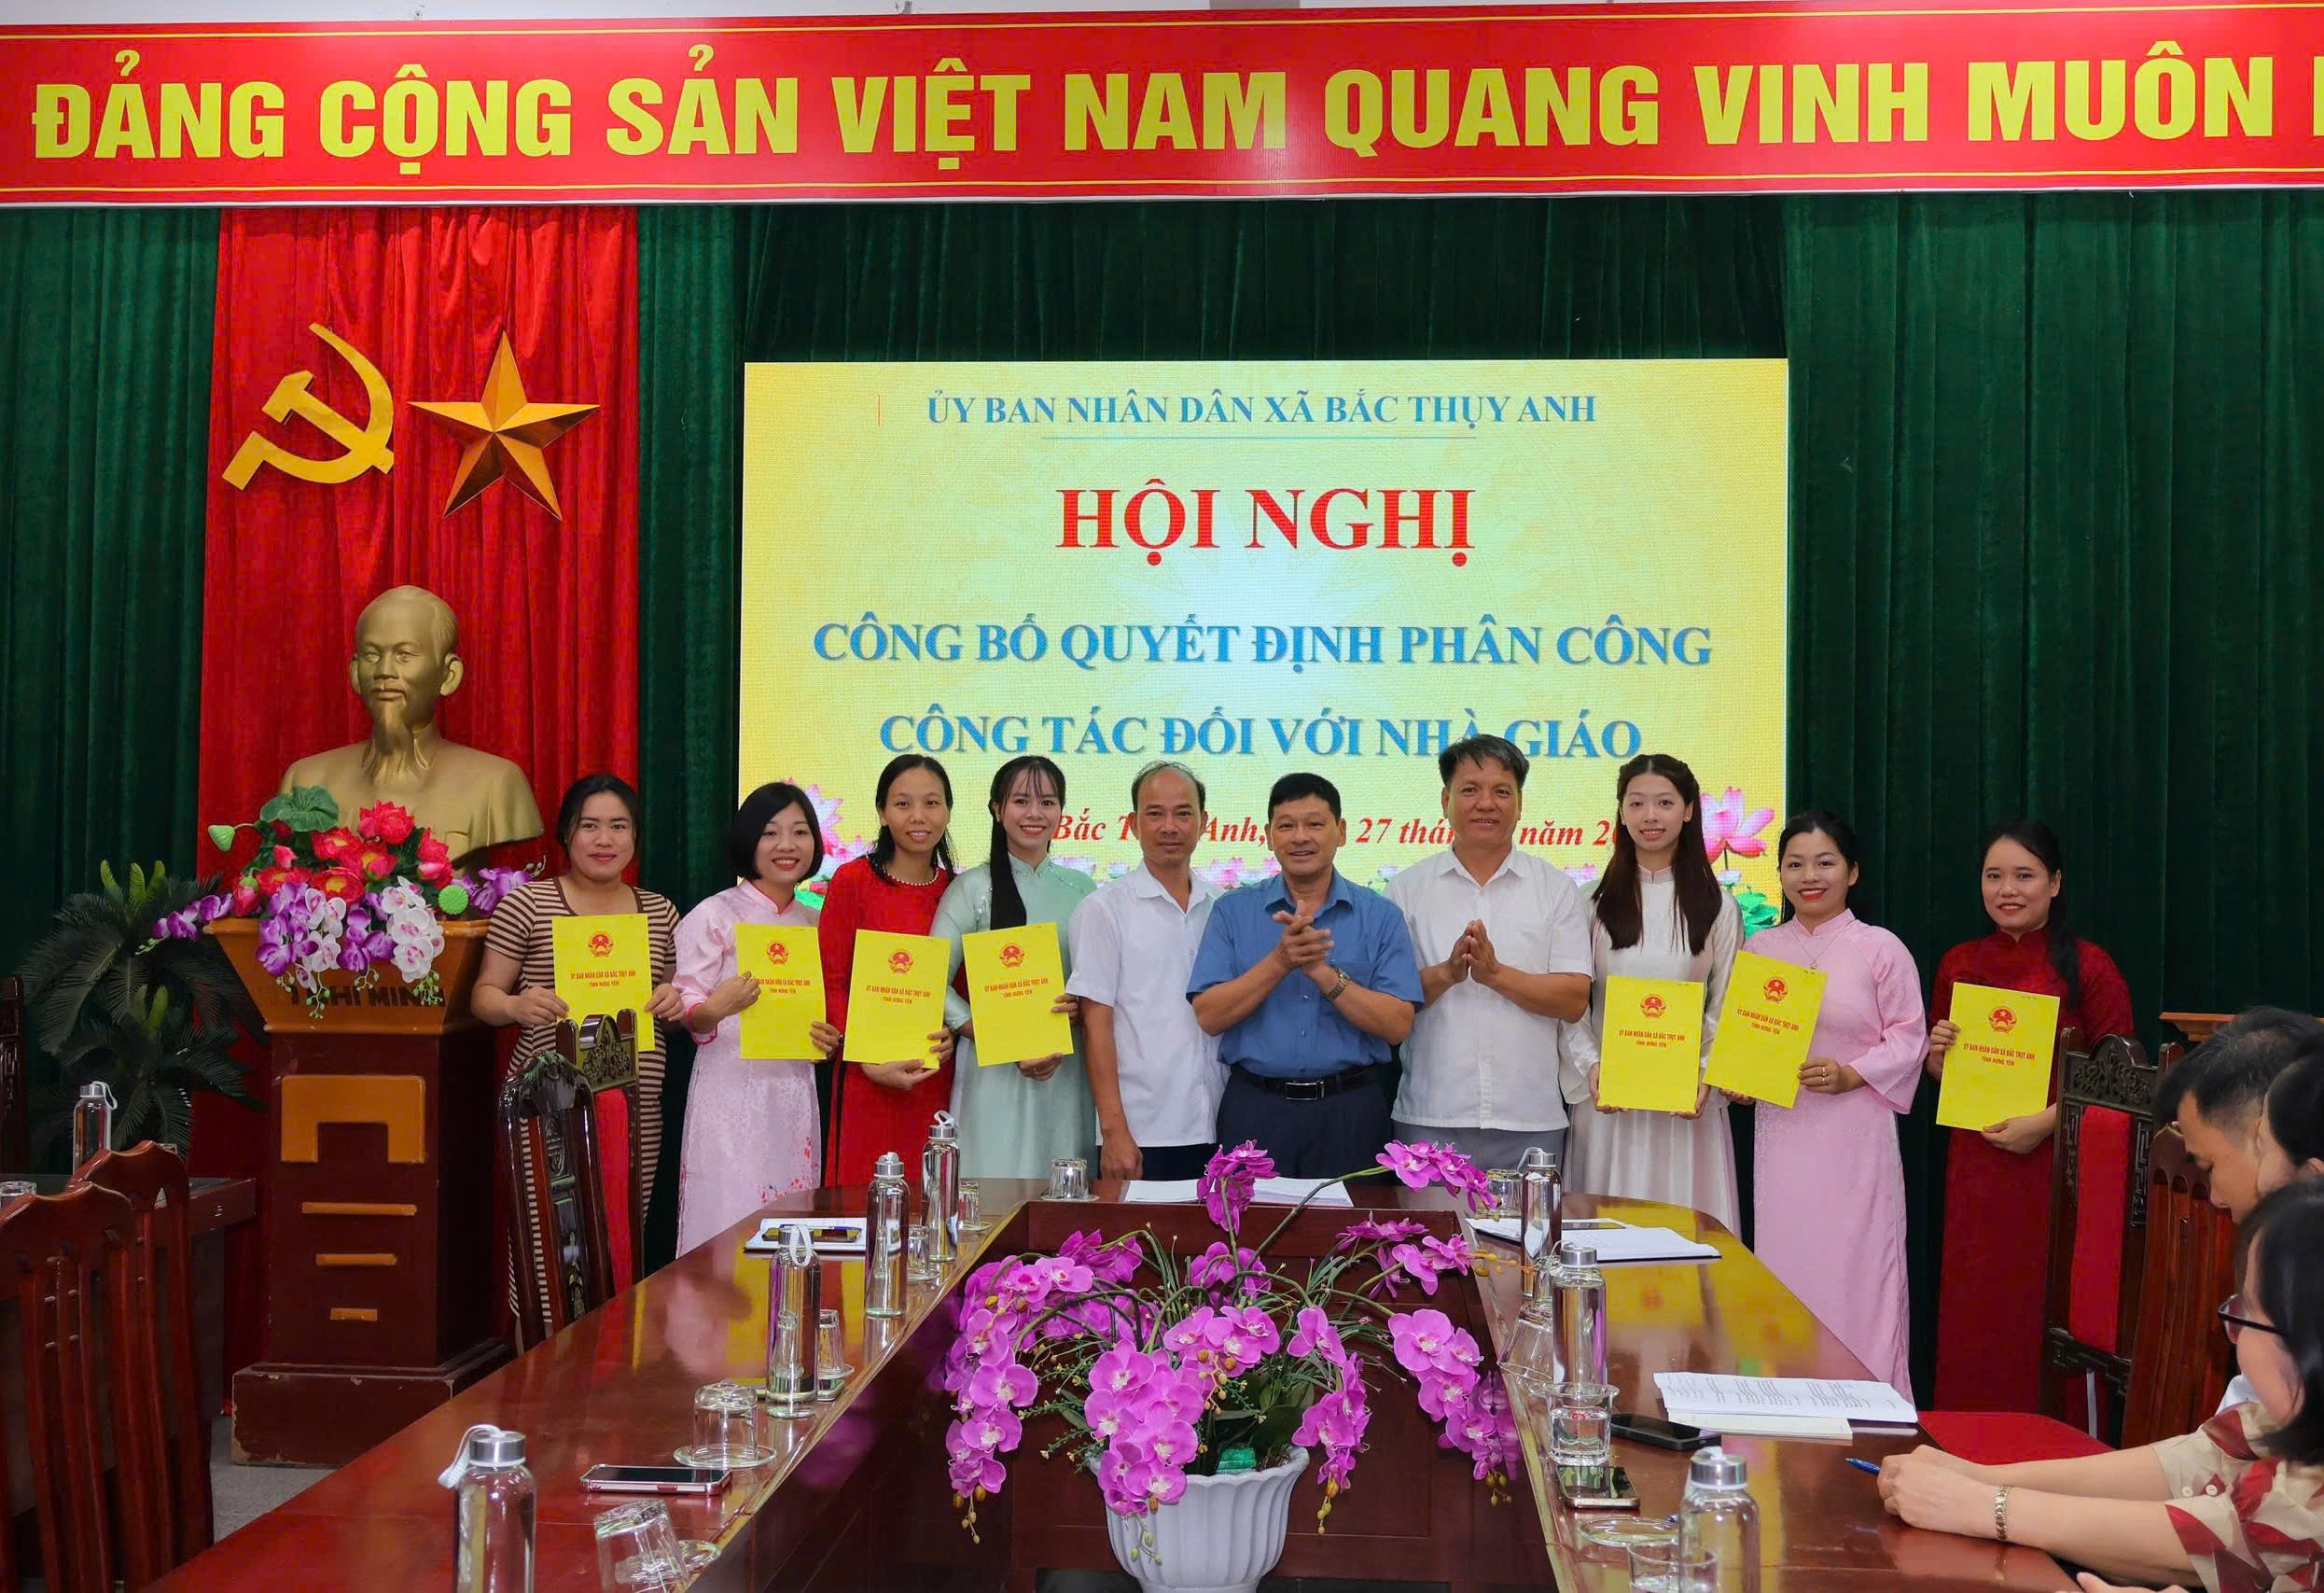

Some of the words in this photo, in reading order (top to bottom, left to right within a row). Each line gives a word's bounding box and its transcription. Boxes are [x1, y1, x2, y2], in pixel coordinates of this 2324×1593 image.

[32, 49, 285, 159] ĐẢNG
[319, 63, 571, 175] CỘNG
[606, 44, 799, 156] SẢN
[831, 58, 1031, 170] VIỆT
[1065, 72, 1287, 151] NAM
[1324, 65, 1659, 158] QUANG
[1693, 62, 1928, 145] VINH
[1968, 40, 2274, 141] MUÔN
[927, 389, 974, 424] ỦY
[984, 397, 1056, 424] BAN
[1067, 389, 1168, 424] NHÂN
[1179, 389, 1253, 423] DÂN
[1264, 390, 1315, 424] XÃ
[1325, 388, 1399, 424] BẮC
[1408, 396, 1510, 429] THỤY
[1517, 396, 1595, 423] ANH
[1055, 478, 1220, 566] HỘI
[1245, 487, 1476, 567] NGHỊ
[814, 611, 962, 662] CÔNG
[976, 613, 1049, 662] BỐ
[1061, 613, 1241, 670] QUYẾT
[1251, 625, 1384, 673] ĐỊNH
[1399, 614, 1543, 665] PHÂN
[1556, 614, 1713, 666] CÔNG
[879, 703, 1029, 754] CÔNG
[1042, 706, 1148, 755] TÁC
[1160, 706, 1255, 756] ĐỐI
[1267, 707, 1360, 757] VỚI
[1504, 709, 1642, 758] GIÁO
[1052, 807, 1106, 840] Bắc
[1355, 817, 1393, 844] 27
[1399, 818, 1454, 844] thá
[1519, 820, 1583, 845] năm
